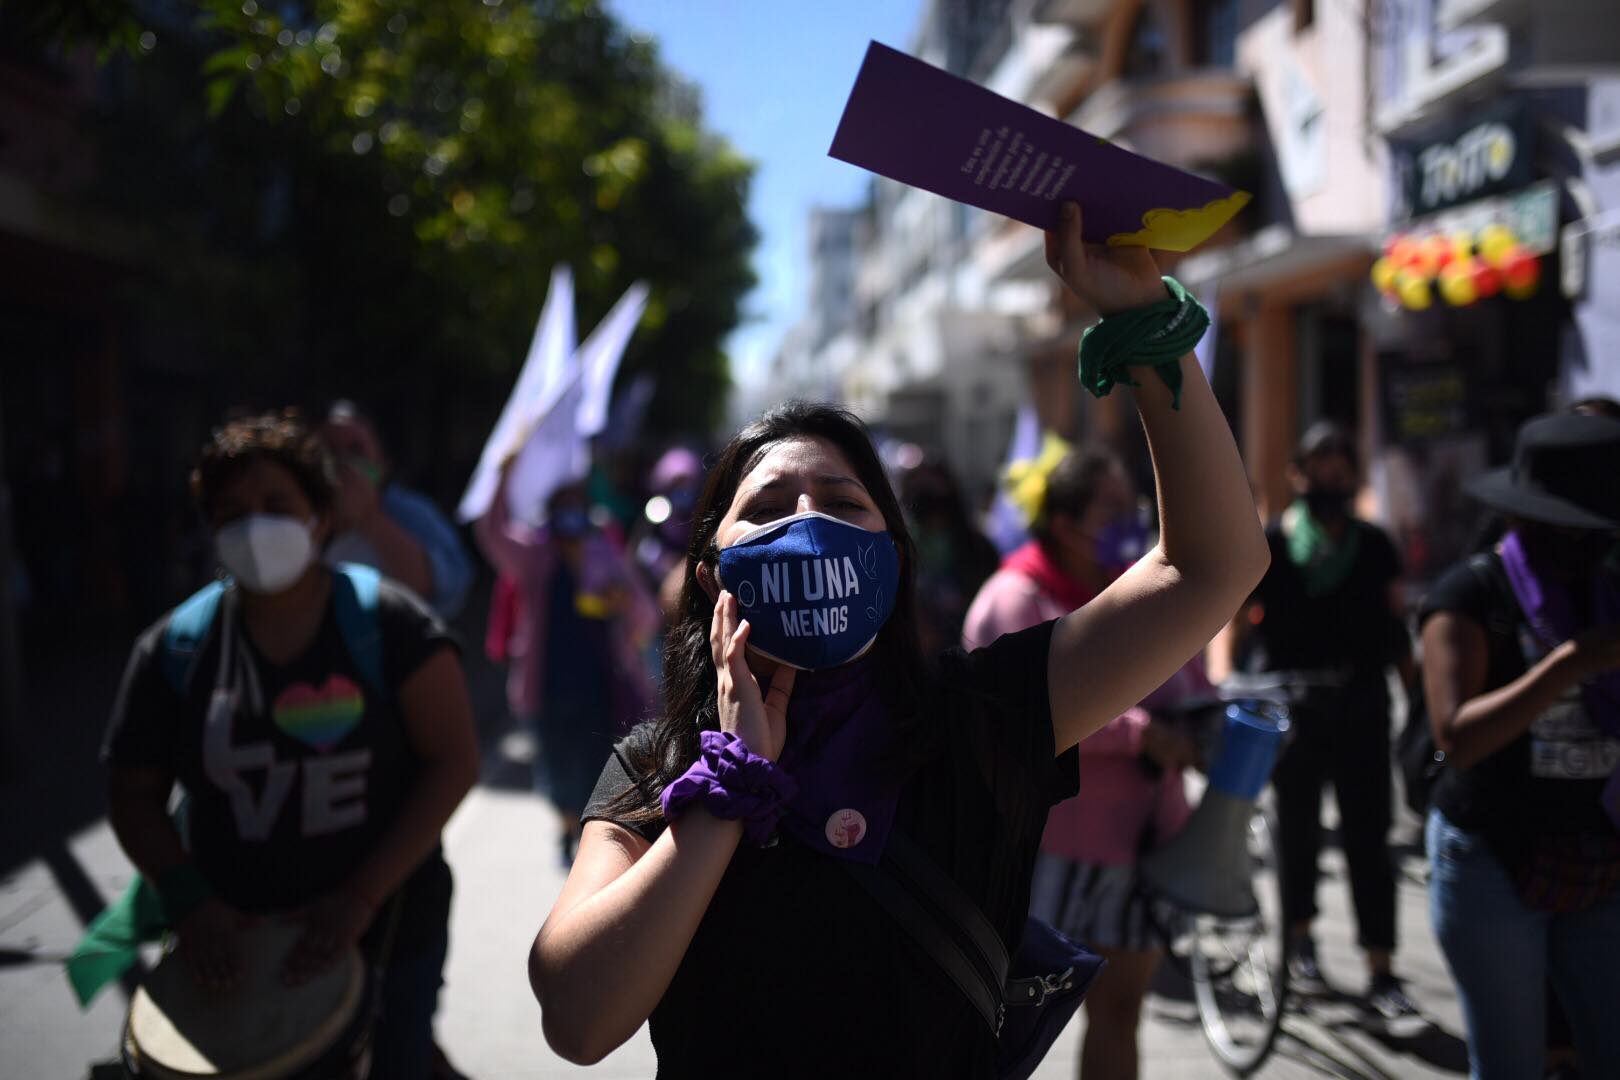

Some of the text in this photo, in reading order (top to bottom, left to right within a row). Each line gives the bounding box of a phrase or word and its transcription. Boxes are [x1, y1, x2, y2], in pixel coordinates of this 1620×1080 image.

[761, 556, 860, 604] NI UNA
[780, 605, 849, 637] MENOS
